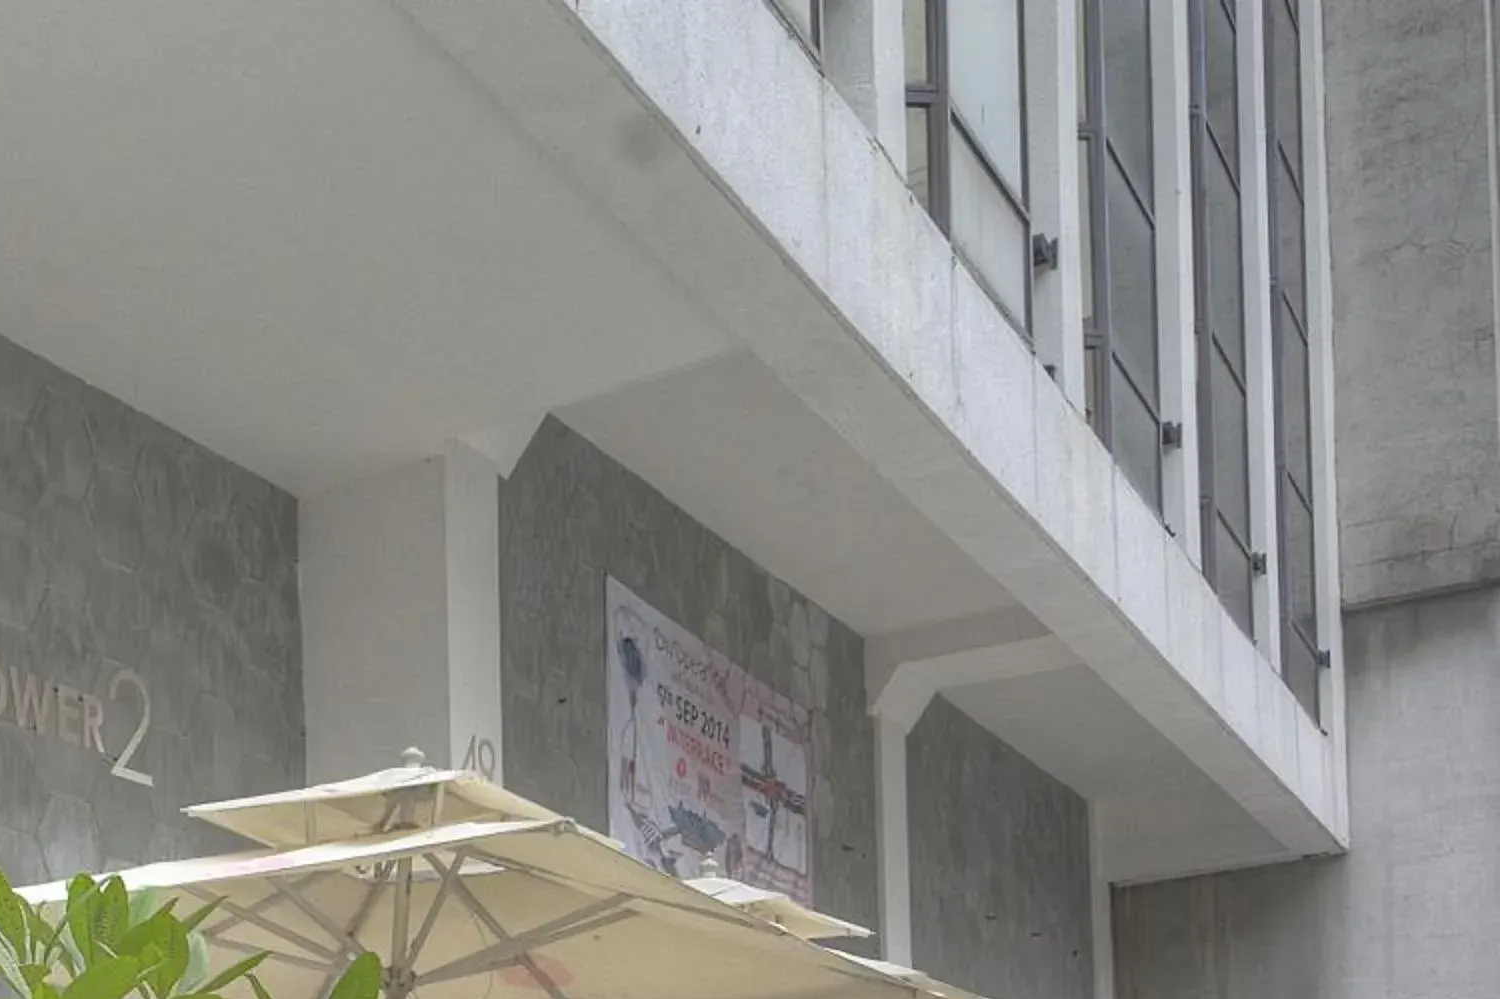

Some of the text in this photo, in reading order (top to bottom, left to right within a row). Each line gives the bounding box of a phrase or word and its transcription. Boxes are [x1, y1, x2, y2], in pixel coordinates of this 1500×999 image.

[108, 668, 154, 788] 2
[676, 696, 701, 728] SEP
[700, 711, 731, 750] 2014
[462, 733, 495, 781] 10
